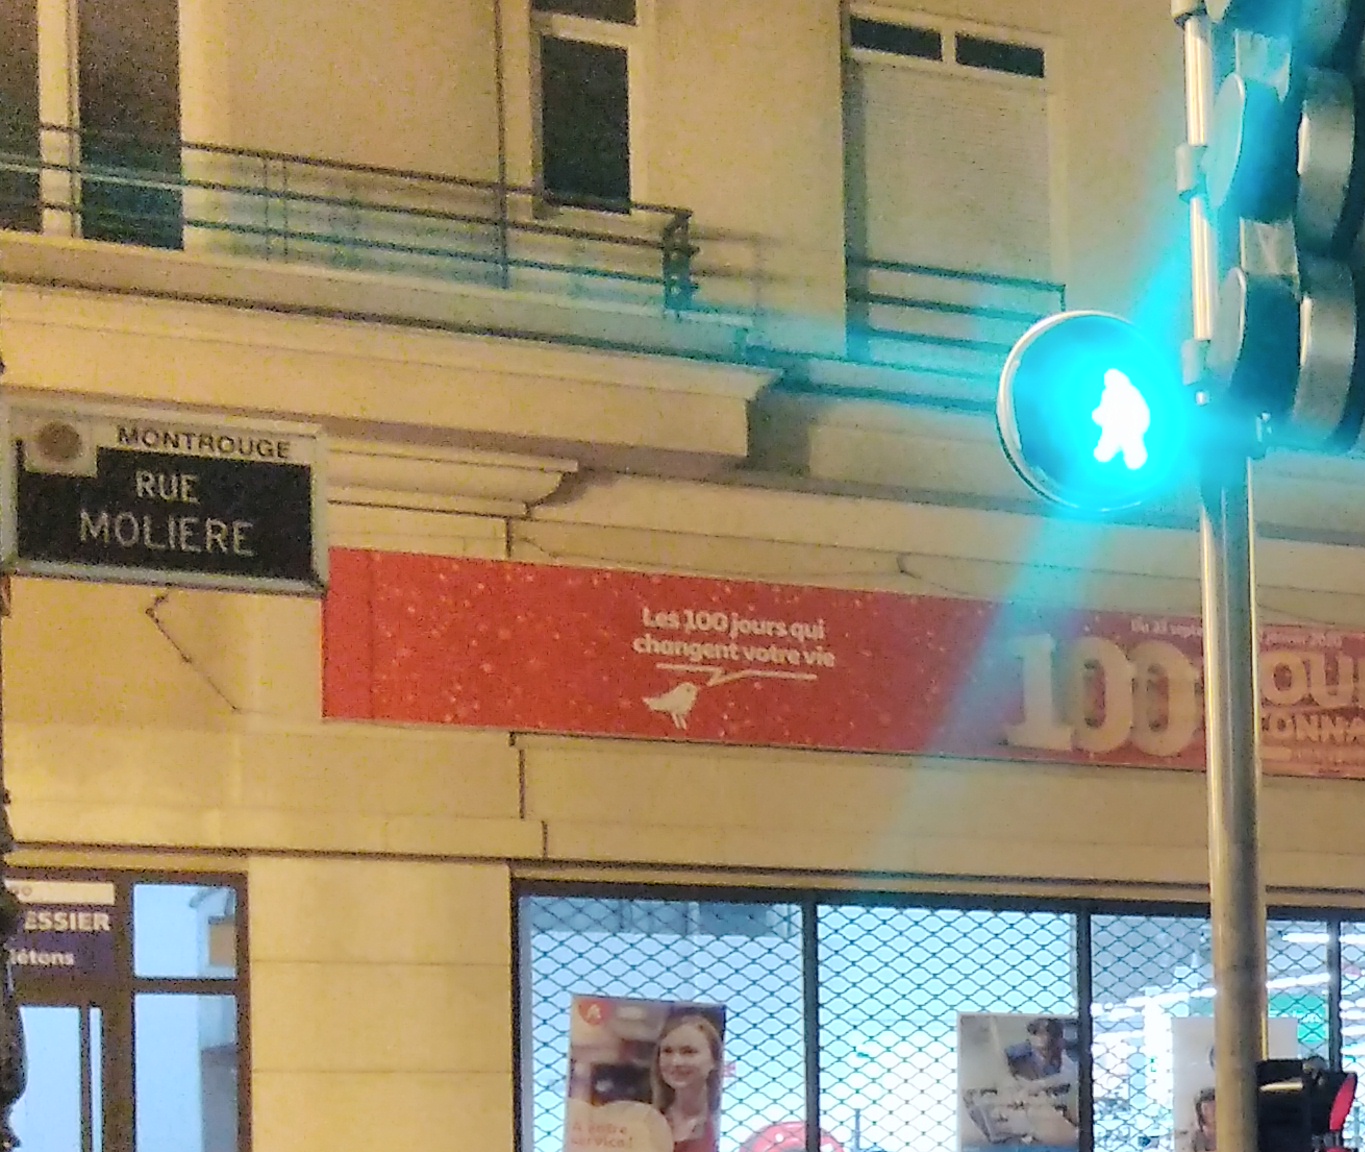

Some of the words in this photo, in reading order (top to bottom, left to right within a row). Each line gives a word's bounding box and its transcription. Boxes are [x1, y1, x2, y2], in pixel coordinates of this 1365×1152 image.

[116, 425, 291, 459] MONTROUGE
[135, 469, 200, 503] RUE
[79, 509, 256, 557] MOLIERE
[641, 607, 679, 630] Les
[683, 609, 727, 633] 100
[729, 612, 788, 638] jours
[791, 618, 824, 642] qui
[632, 633, 739, 662] changent
[742, 642, 800, 665] votre
[803, 646, 835, 667] vie
[1000, 631, 1202, 757] 100
